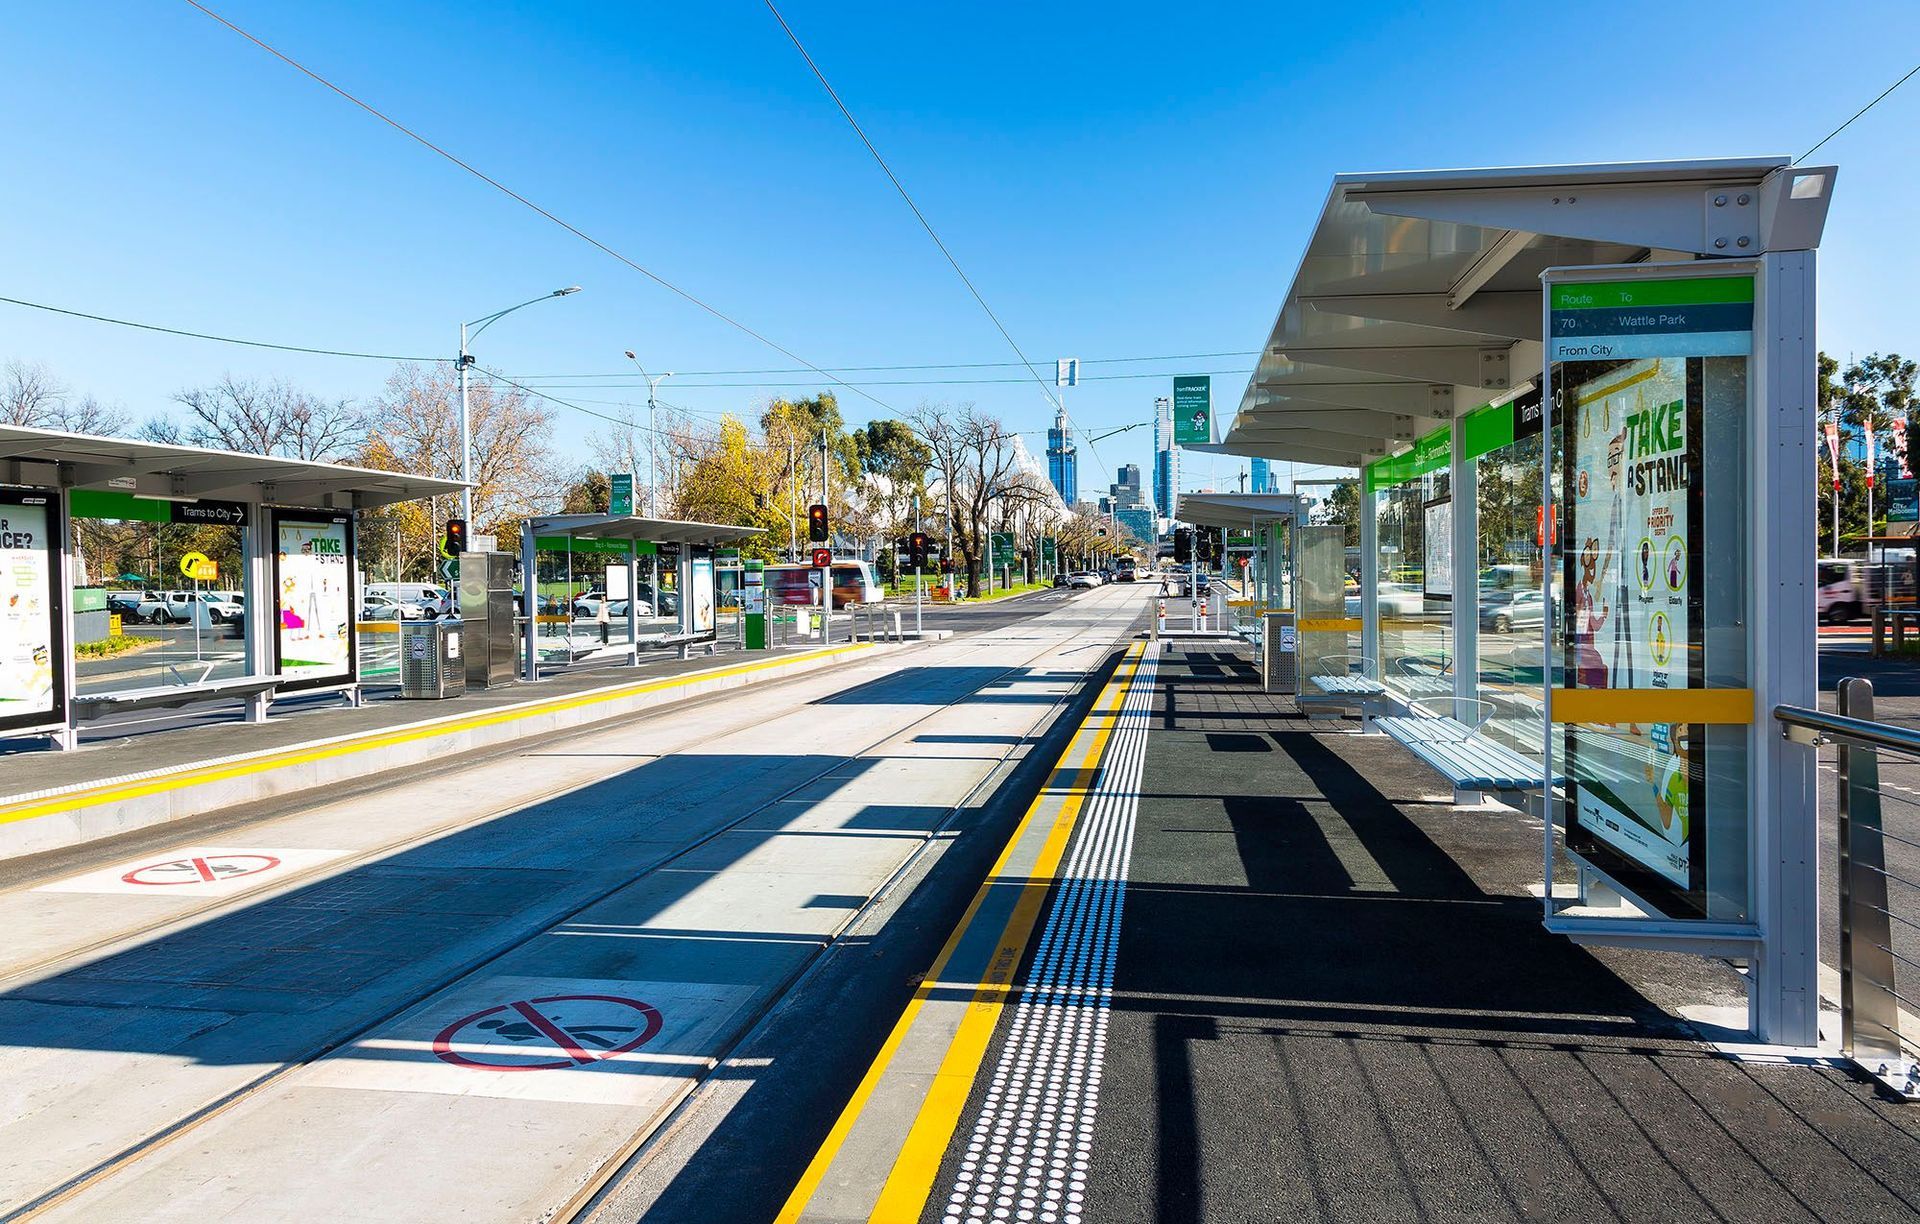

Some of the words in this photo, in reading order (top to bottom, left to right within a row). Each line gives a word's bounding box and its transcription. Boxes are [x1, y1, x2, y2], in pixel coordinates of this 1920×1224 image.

[1561, 294, 1592, 305] Route
[1619, 292, 1633, 303] To
[1561, 318, 1576, 328] 70
[1619, 315, 1656, 327] Wattle
[1659, 314, 1686, 325] Park
[1558, 345, 1588, 356] From
[1590, 344, 1613, 356] City
[1521, 404, 1540, 423] Trams
[1626, 399, 1684, 460] TAKE
[1628, 465, 1634, 489] A
[1635, 453, 1691, 497] STAND
[181, 506, 207, 518] Trams
[207, 508, 215, 518] to
[216, 508, 231, 520] City
[1647, 514, 1675, 529] PRIORITY
[0, 531, 33, 549] CE?
[312, 538, 341, 554] TAKE
